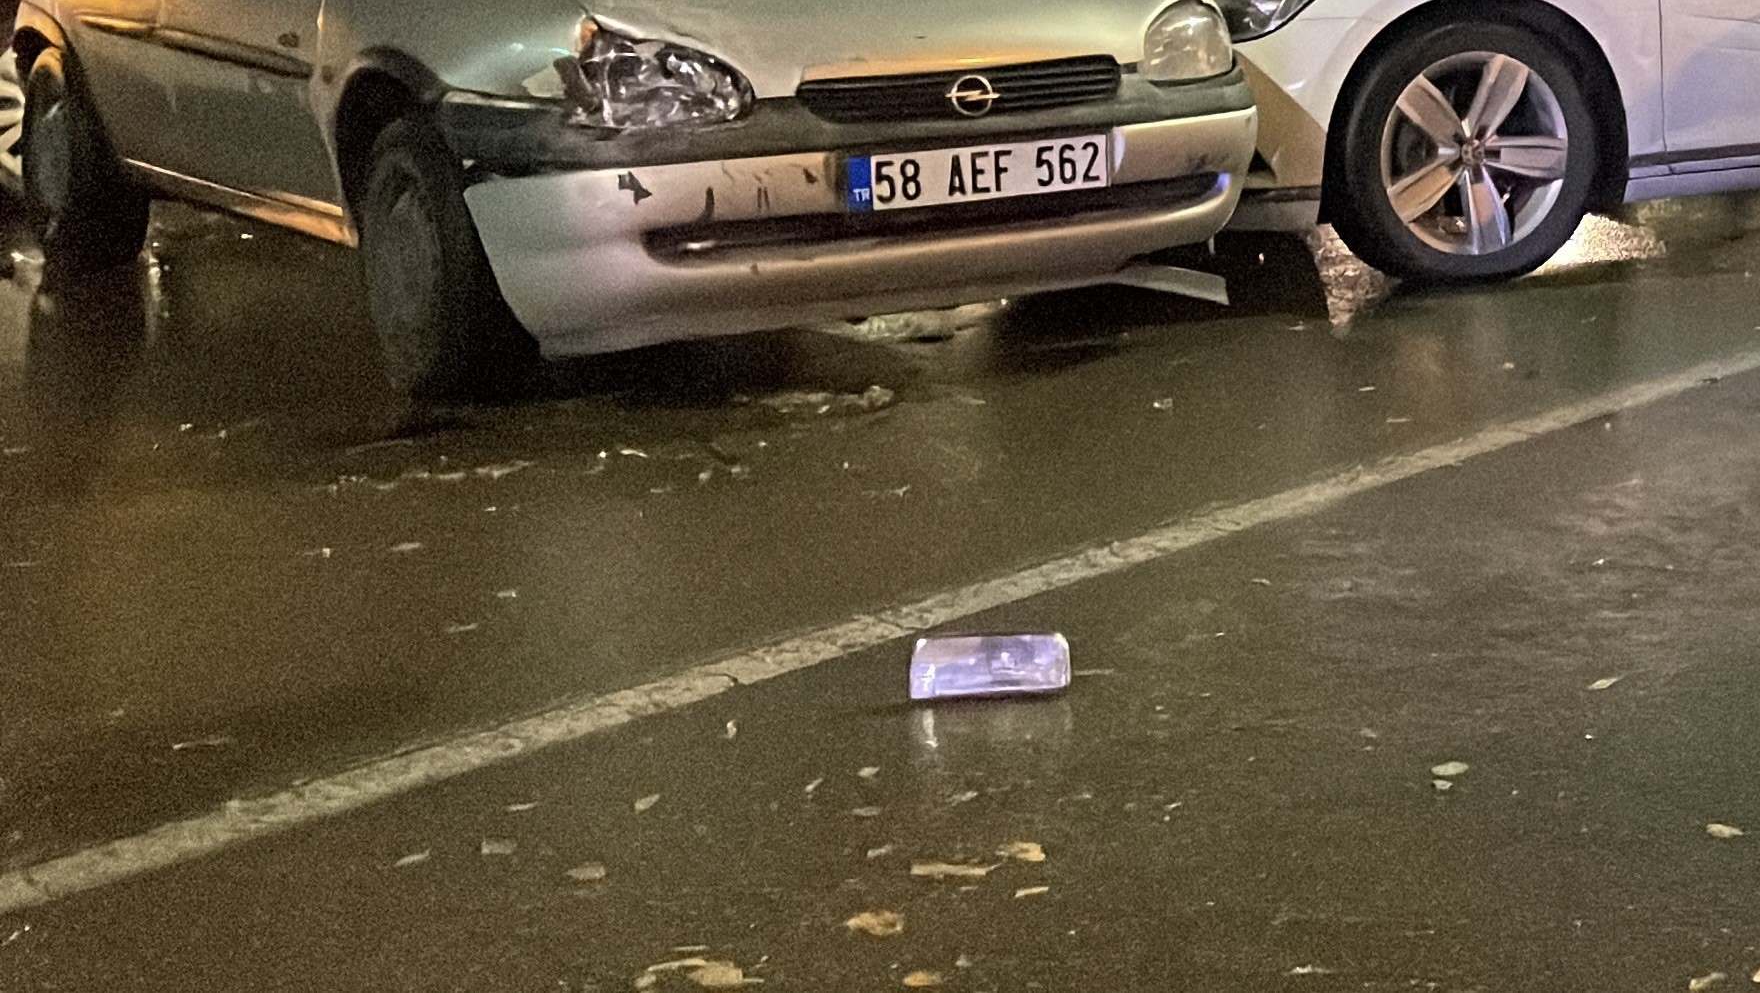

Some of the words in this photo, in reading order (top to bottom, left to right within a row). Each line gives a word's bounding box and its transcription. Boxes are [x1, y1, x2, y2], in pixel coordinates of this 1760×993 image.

[852, 188, 871, 202] TR
[875, 158, 922, 204] 58
[948, 149, 1012, 197] AEF
[1035, 141, 1100, 187] 562
